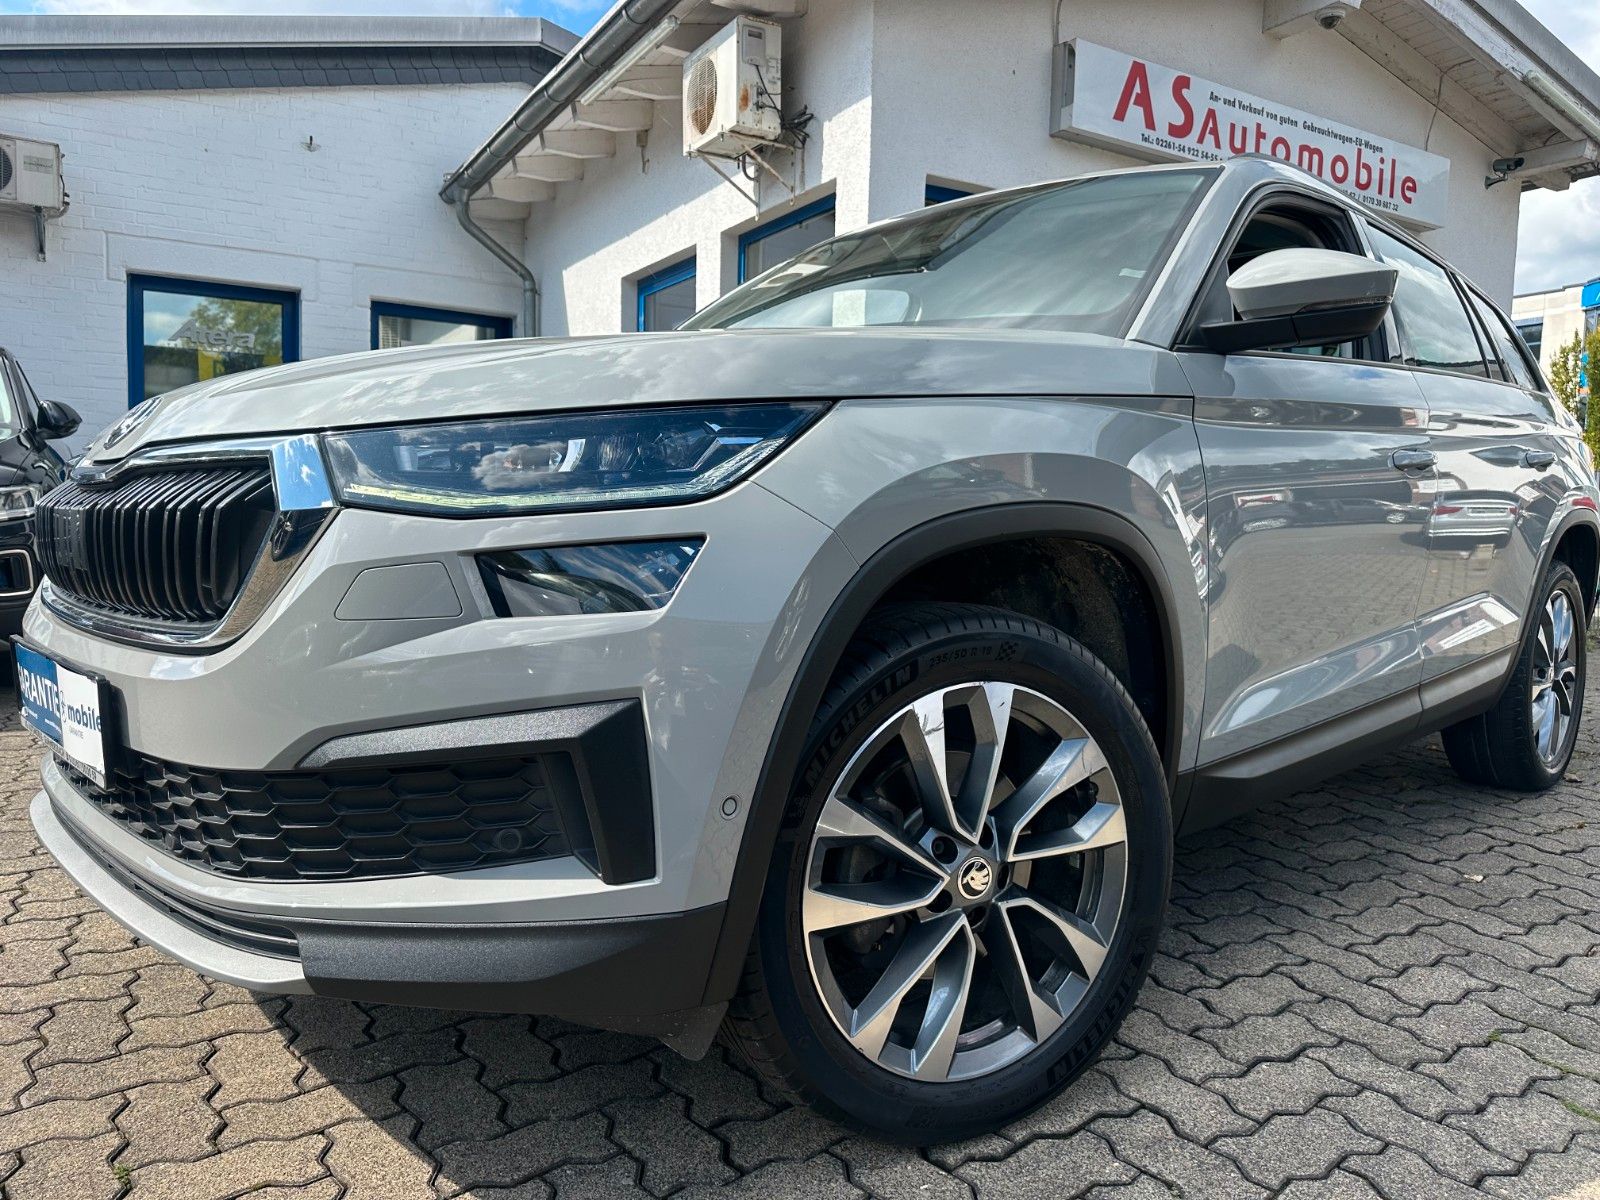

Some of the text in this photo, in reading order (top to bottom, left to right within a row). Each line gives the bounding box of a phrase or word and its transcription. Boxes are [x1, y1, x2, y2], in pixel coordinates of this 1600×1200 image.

[1209, 91, 1383, 153] An- und Verkauf von guten Gebrauchtwagen-EU-Wagen
[1141, 133, 1154, 145] Tel.:
[1187, 146, 1199, 157] 922
[168, 319, 256, 348] Atera
[67, 703, 101, 732] mobile
[804, 662, 914, 787] MICHELIN
[1054, 962, 1138, 1082] MICHELIN
